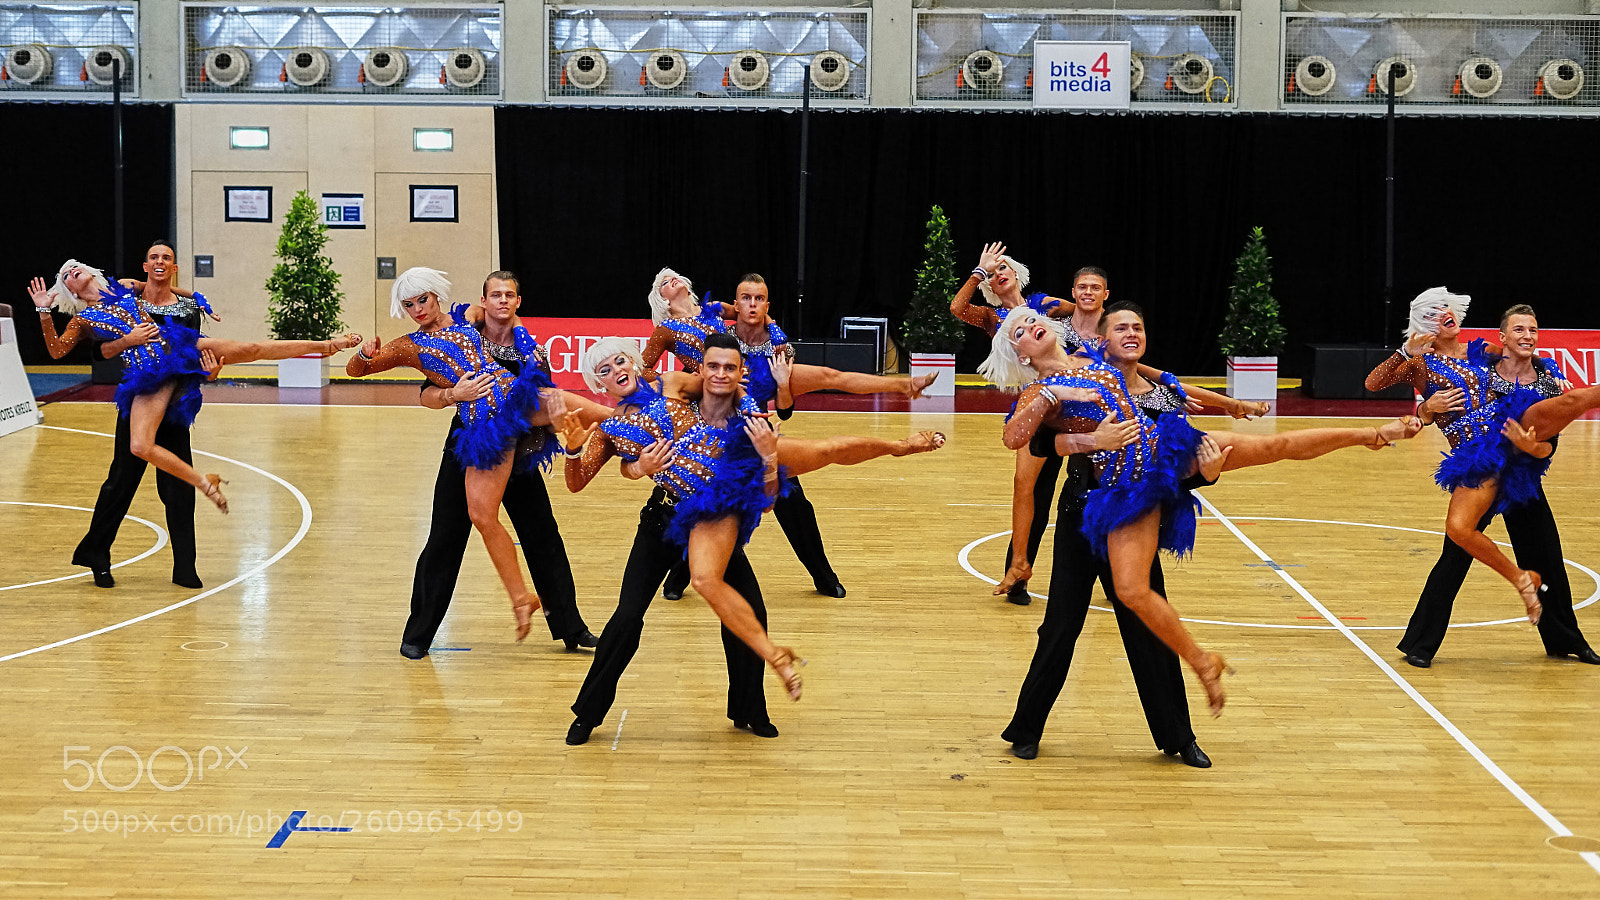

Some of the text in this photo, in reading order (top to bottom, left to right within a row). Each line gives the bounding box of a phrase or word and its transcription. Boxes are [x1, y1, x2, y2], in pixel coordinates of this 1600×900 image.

[1050, 52, 1111, 78] bits 4
[1050, 76, 1111, 92] media
